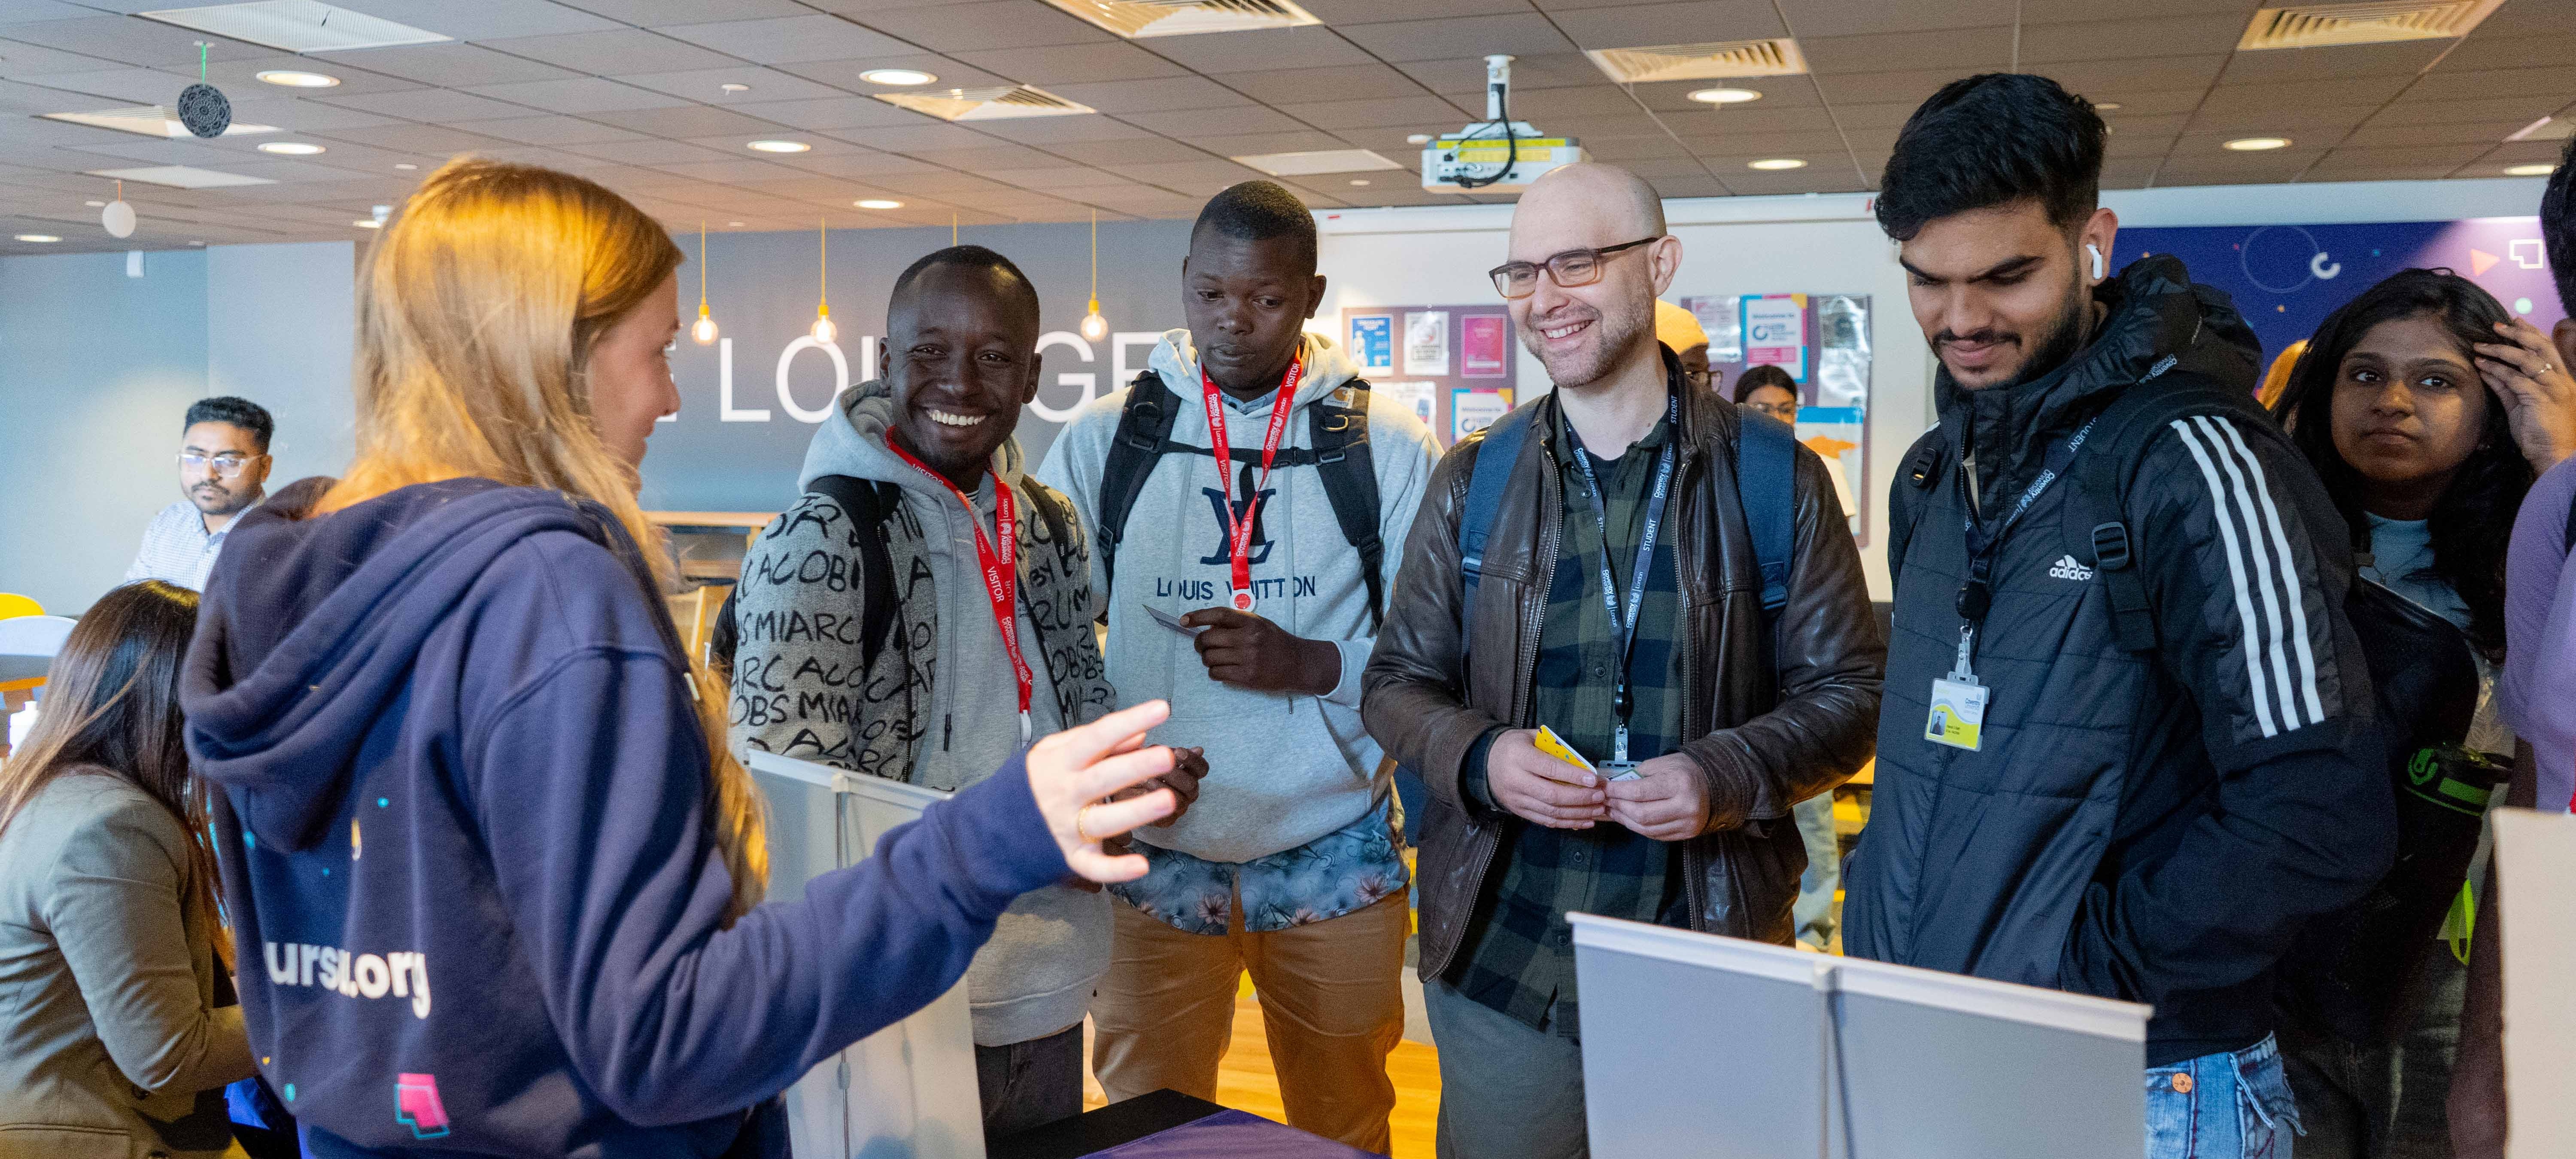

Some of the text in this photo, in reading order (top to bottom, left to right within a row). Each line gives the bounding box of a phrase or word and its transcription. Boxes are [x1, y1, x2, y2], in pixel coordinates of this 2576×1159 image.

[1285, 363, 1300, 387] VISITOR
[1279, 397, 1287, 415] London
[1266, 425, 1278, 450] Coventry
[1578, 448, 1590, 468] Coventry
[1220, 460, 1229, 489] VISITOR
[1654, 473, 1665, 498] Coventry
[2027, 469, 2051, 494] University
[2031, 472, 2055, 498] Coventry
[1643, 519, 1656, 552] STUDENT
[987, 566, 1005, 603] VISITOR
[1605, 569, 1613, 595] Coventry
[2049, 566, 2093, 581] adidas
[1157, 577, 1214, 601] LOUIS
[1626, 602, 1634, 628] Coventry
[1002, 618, 1014, 646] University
[1006, 616, 1015, 645] Coventry
